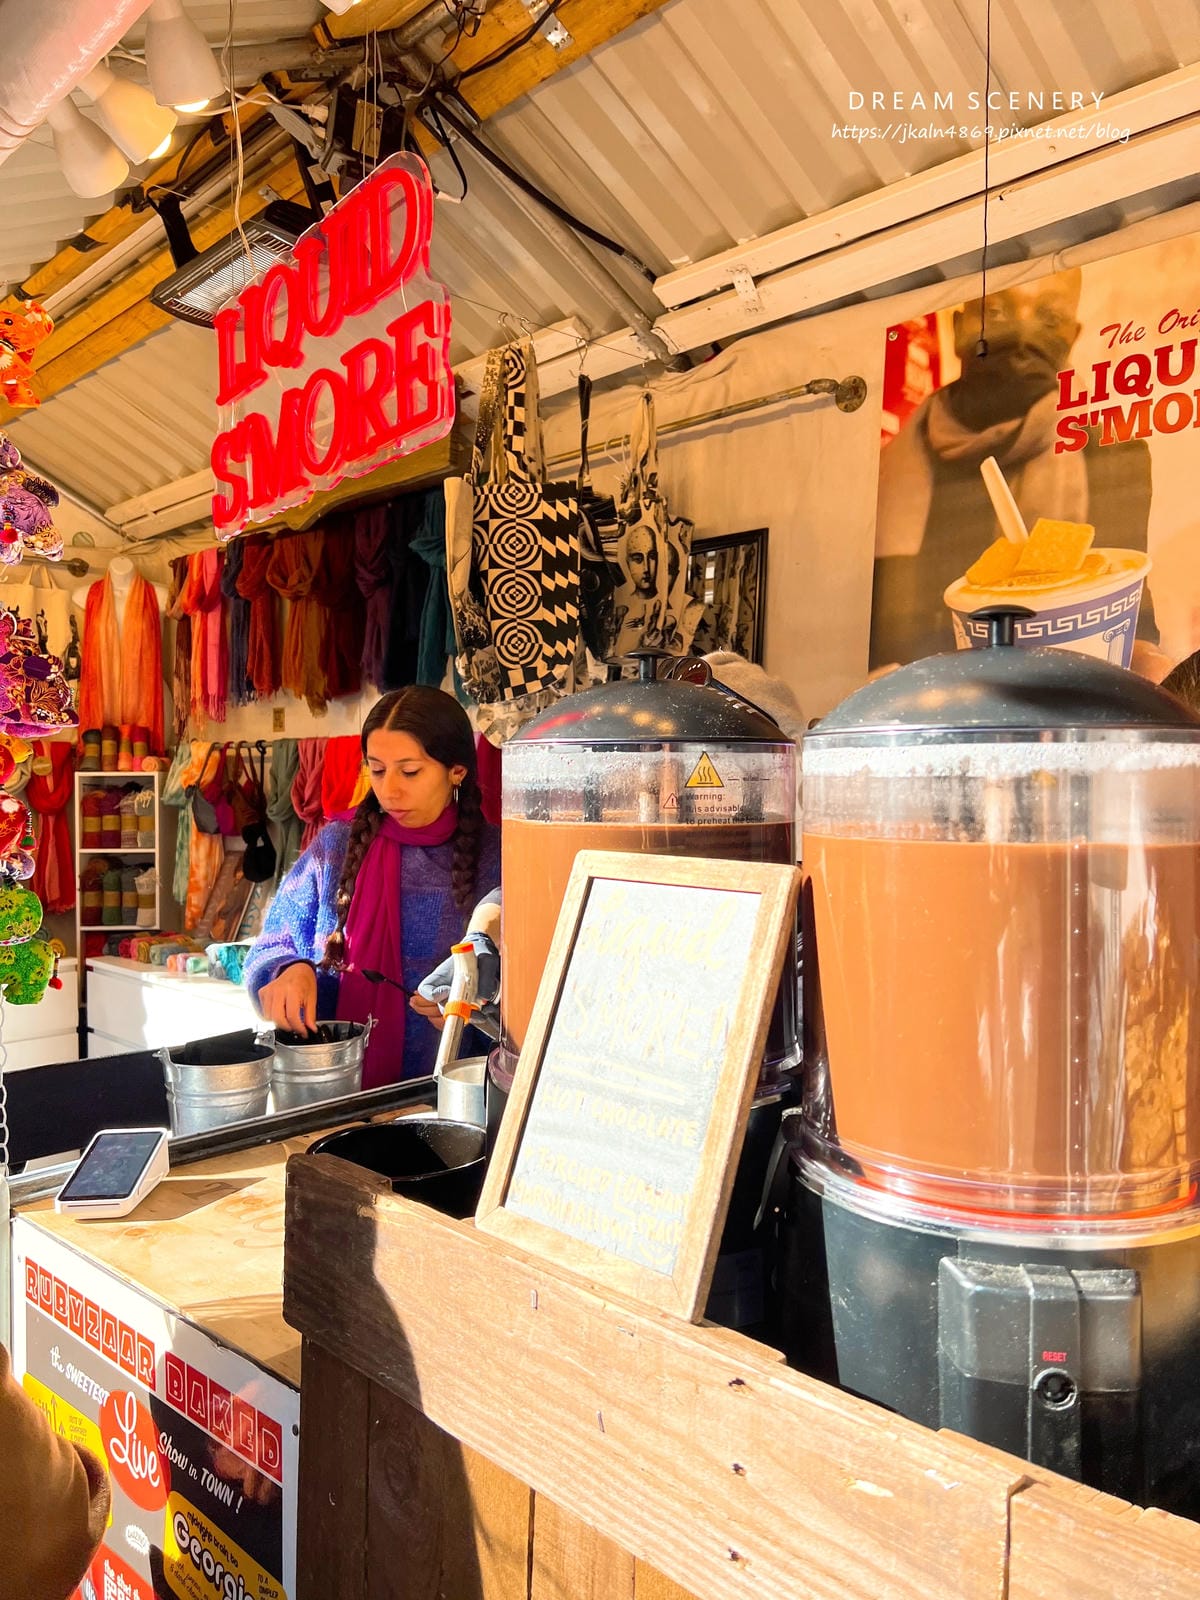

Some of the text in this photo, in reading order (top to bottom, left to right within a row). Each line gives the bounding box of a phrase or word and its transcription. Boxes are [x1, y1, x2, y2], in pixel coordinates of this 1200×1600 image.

[214, 168, 425, 406] LIQUID
[1100, 320, 1146, 349] The
[1056, 338, 1198, 411] LIQU
[1055, 388, 1200, 454] S'MO
[686, 792, 726, 802] Warning:
[26, 1260, 281, 1470] RUBYZAAR BAKED
[50, 1345, 110, 1408] the SWEETEST
[1042, 1351, 1067, 1362] RESET
[109, 1391, 160, 1488] Live
[158, 1432, 188, 1474] Show
[188, 1460, 198, 1480] in
[173, 1511, 255, 1600] Georgi
